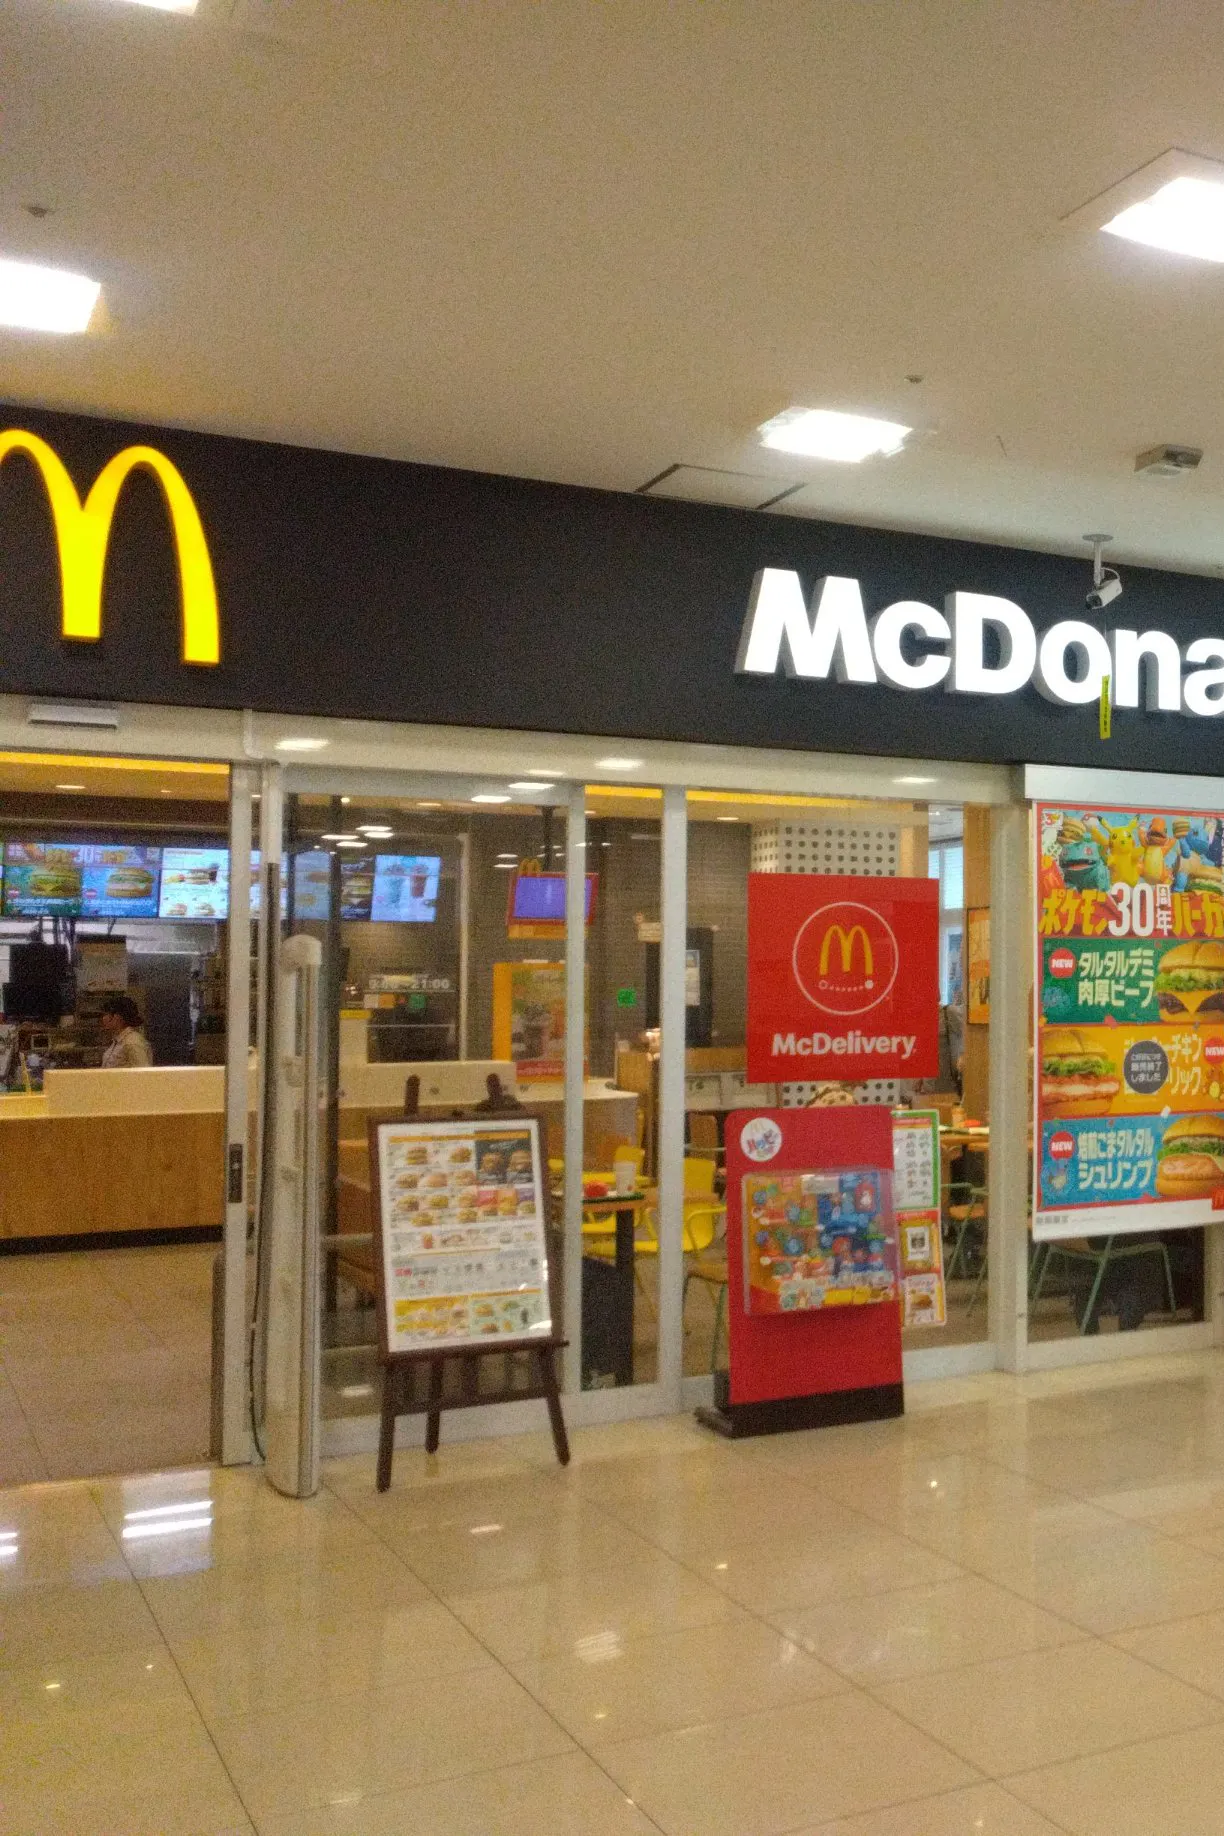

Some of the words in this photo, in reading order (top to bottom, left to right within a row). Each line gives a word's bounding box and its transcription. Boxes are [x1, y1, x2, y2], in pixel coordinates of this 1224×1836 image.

[1051, 958, 1074, 969] NEW
[771, 1029, 916, 1060] McDelivery
[1130, 1072, 1162, 1083] しました
[1051, 1141, 1074, 1152] NEW
